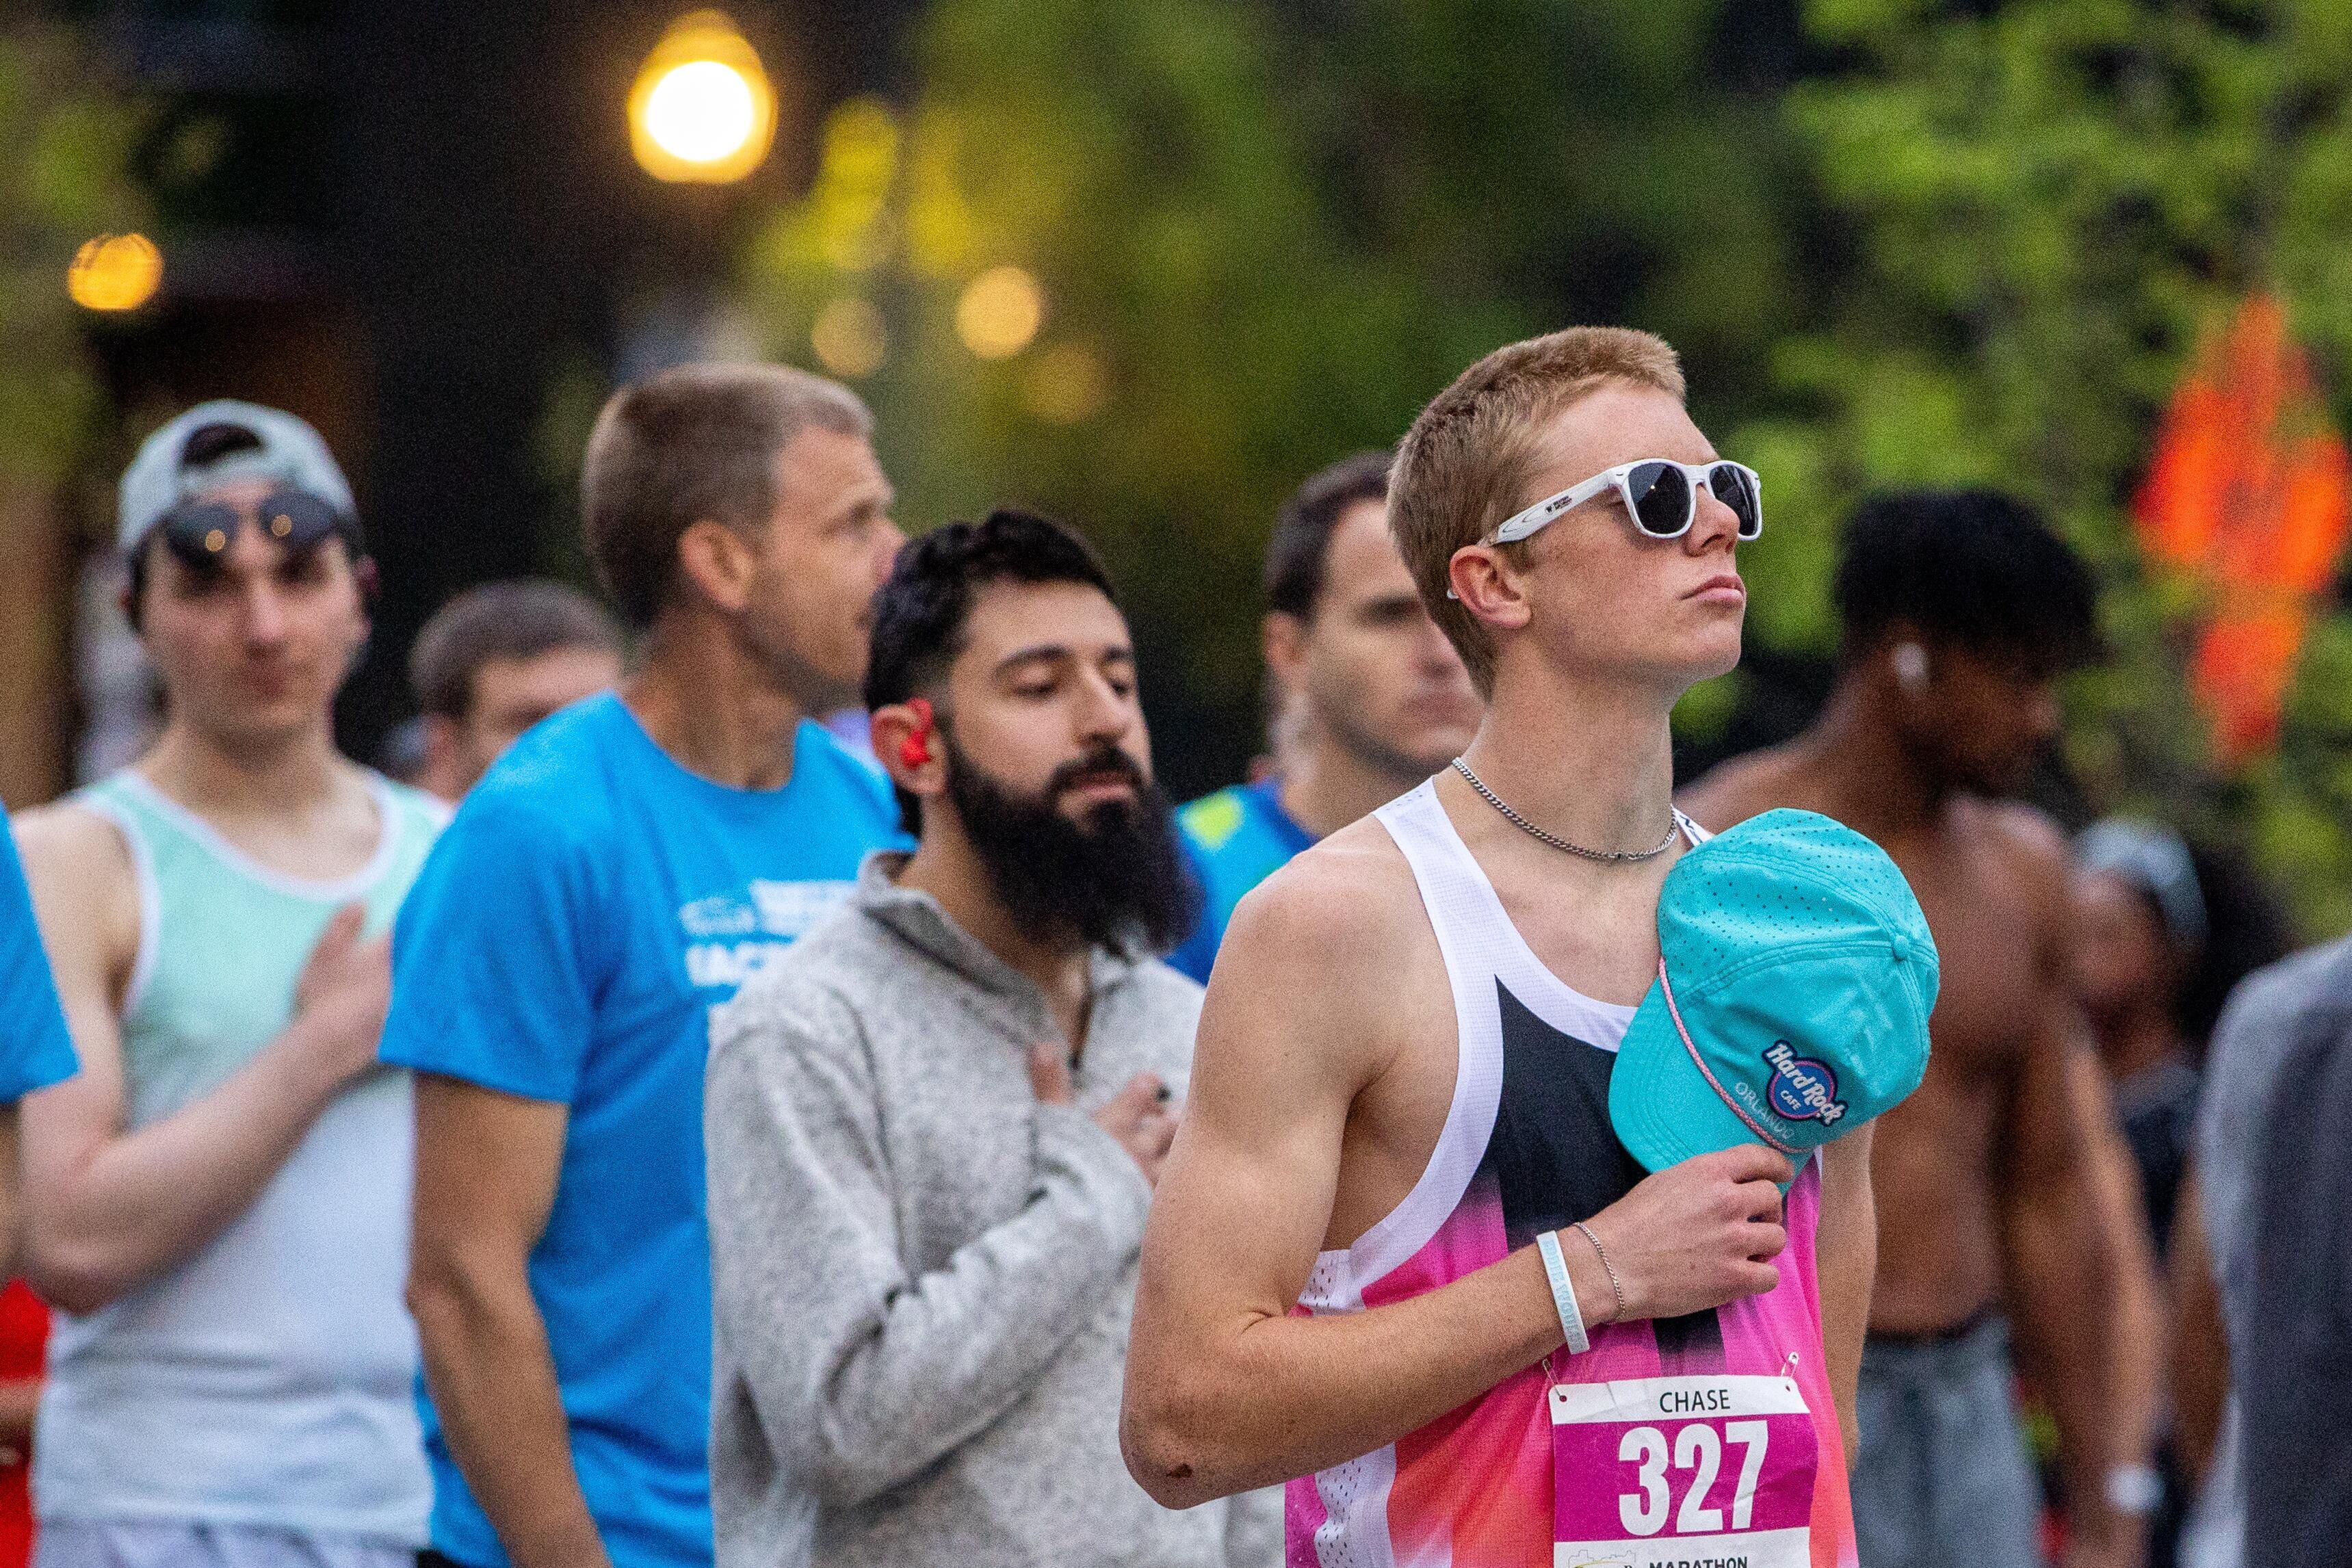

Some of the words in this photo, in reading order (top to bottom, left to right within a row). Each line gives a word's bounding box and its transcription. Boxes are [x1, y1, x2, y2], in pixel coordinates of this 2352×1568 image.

[1735, 1082, 1794, 1139] ORLANDO
[1766, 1044, 1816, 1089] Hard
[1803, 1083, 1845, 1125] Rock
[1781, 1090, 1801, 1110] CAFE
[1660, 1389, 1731, 1413] CHASE
[1619, 1420, 1768, 1536] 327
